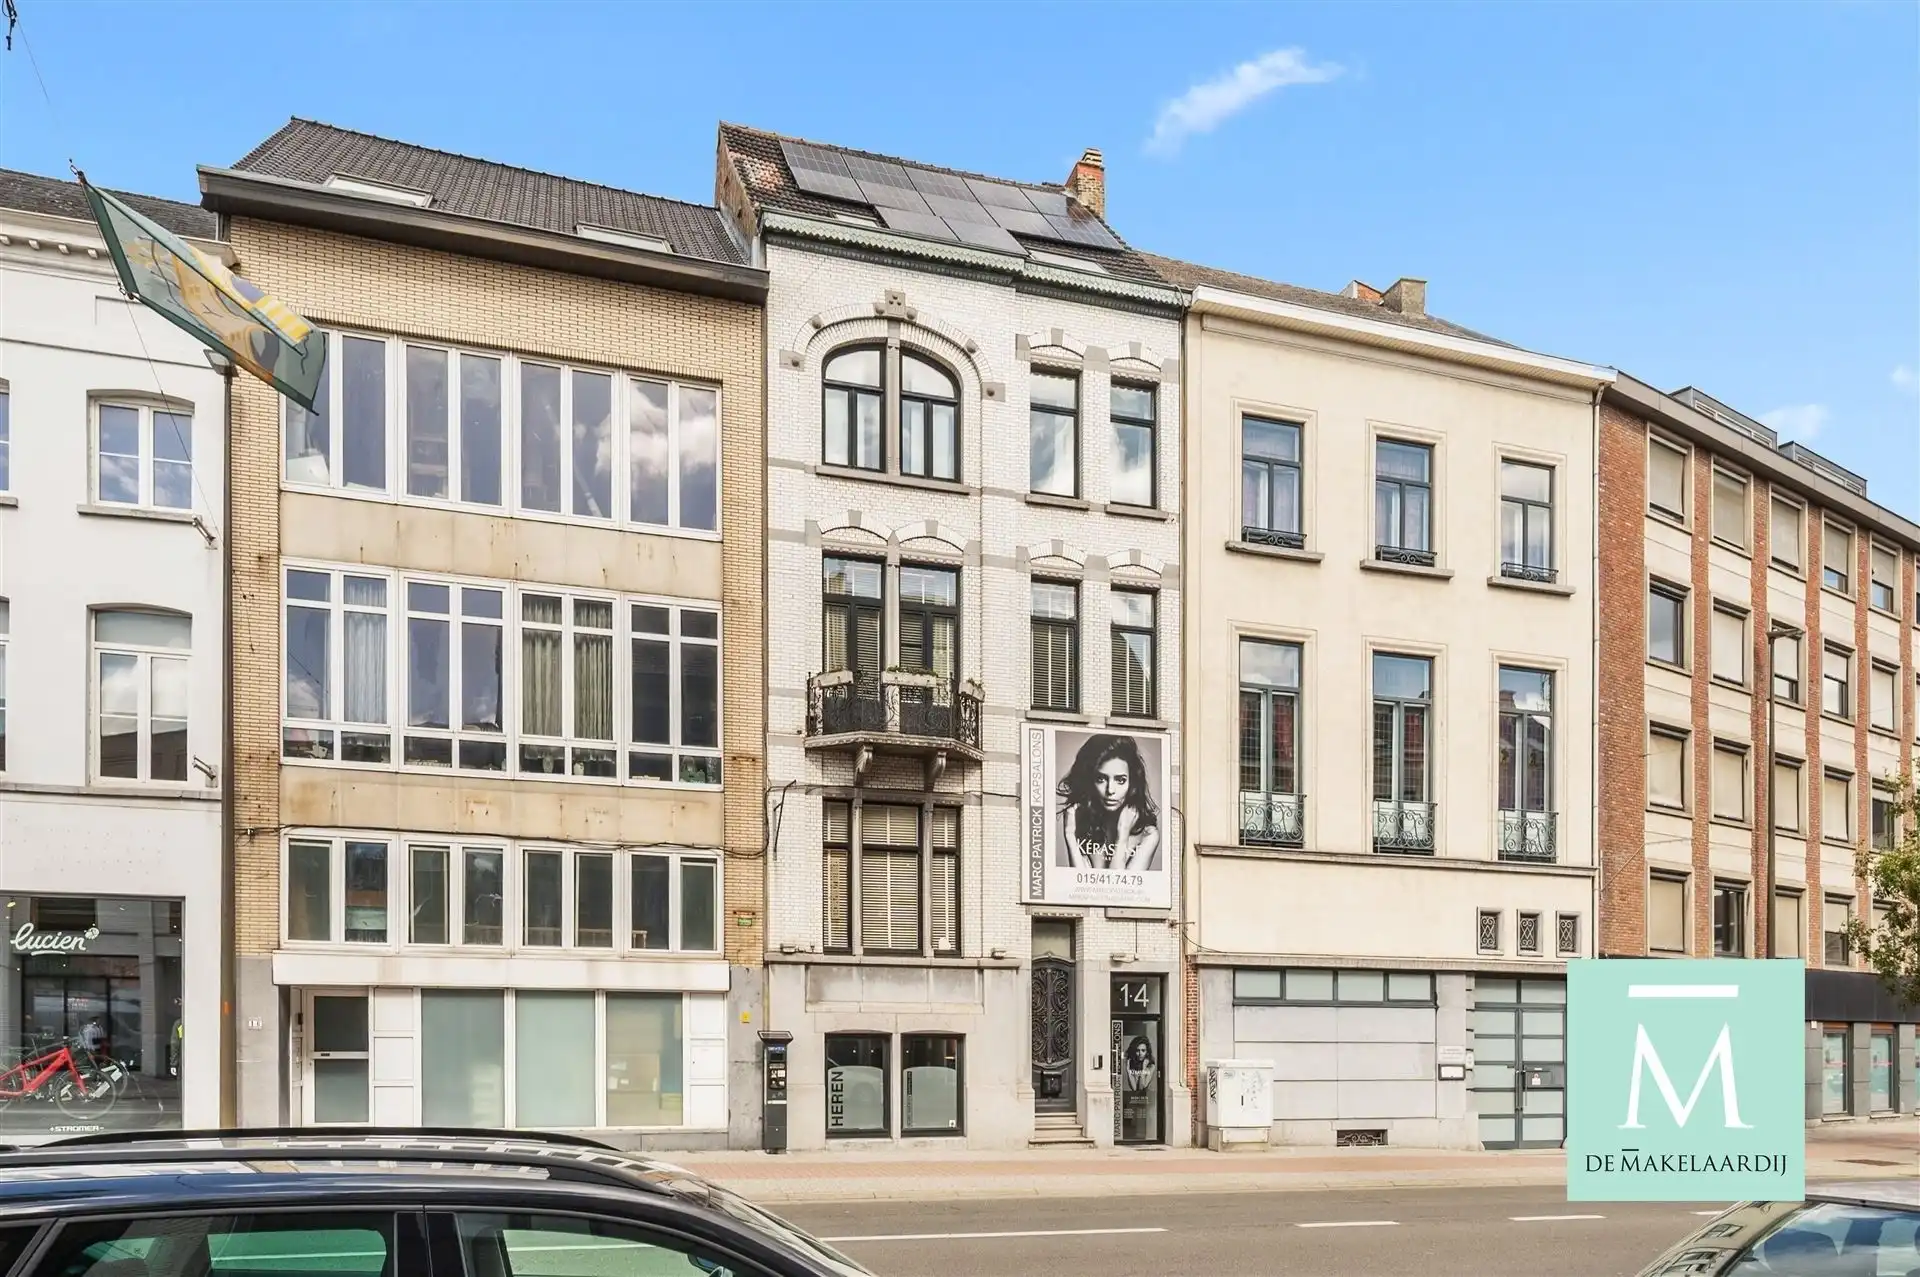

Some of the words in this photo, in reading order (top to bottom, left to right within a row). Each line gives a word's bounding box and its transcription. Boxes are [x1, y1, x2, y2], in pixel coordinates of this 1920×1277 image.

[1031, 731, 1043, 804] KAPSALONS
[1032, 808, 1043, 859] PATRICK
[1076, 838, 1143, 857] KÉRASS
[1032, 861, 1043, 897] MARC
[1076, 872, 1143, 886] 015/41.74.79
[1120, 983, 1149, 1008] 14
[831, 1071, 844, 1127] HEREN
